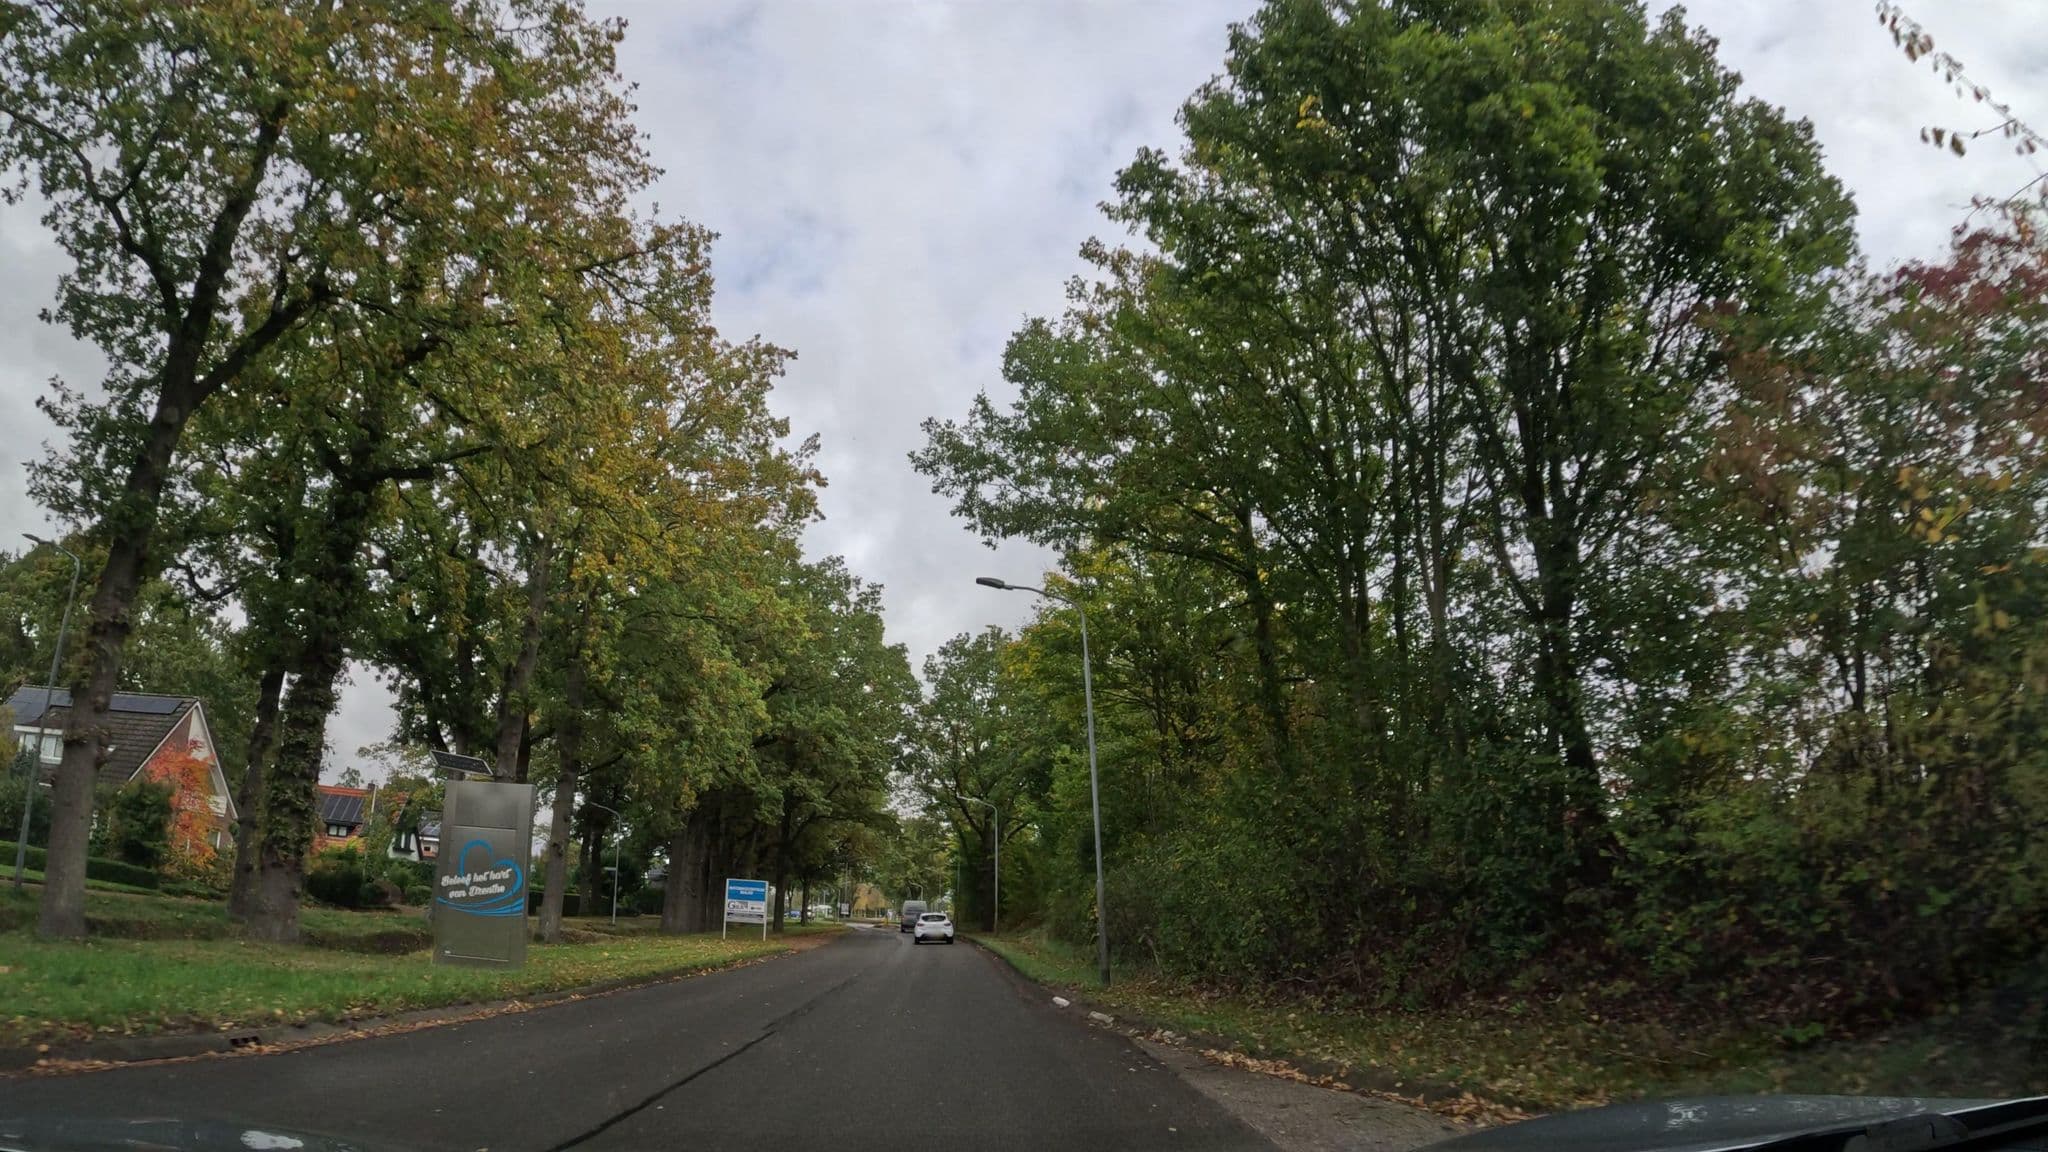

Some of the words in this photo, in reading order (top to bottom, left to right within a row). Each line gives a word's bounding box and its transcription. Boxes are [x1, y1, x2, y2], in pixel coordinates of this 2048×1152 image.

[473, 871, 489, 882] het
[489, 868, 512, 880] hart
[449, 890, 467, 898] van
[468, 883, 505, 896] Drenthe
